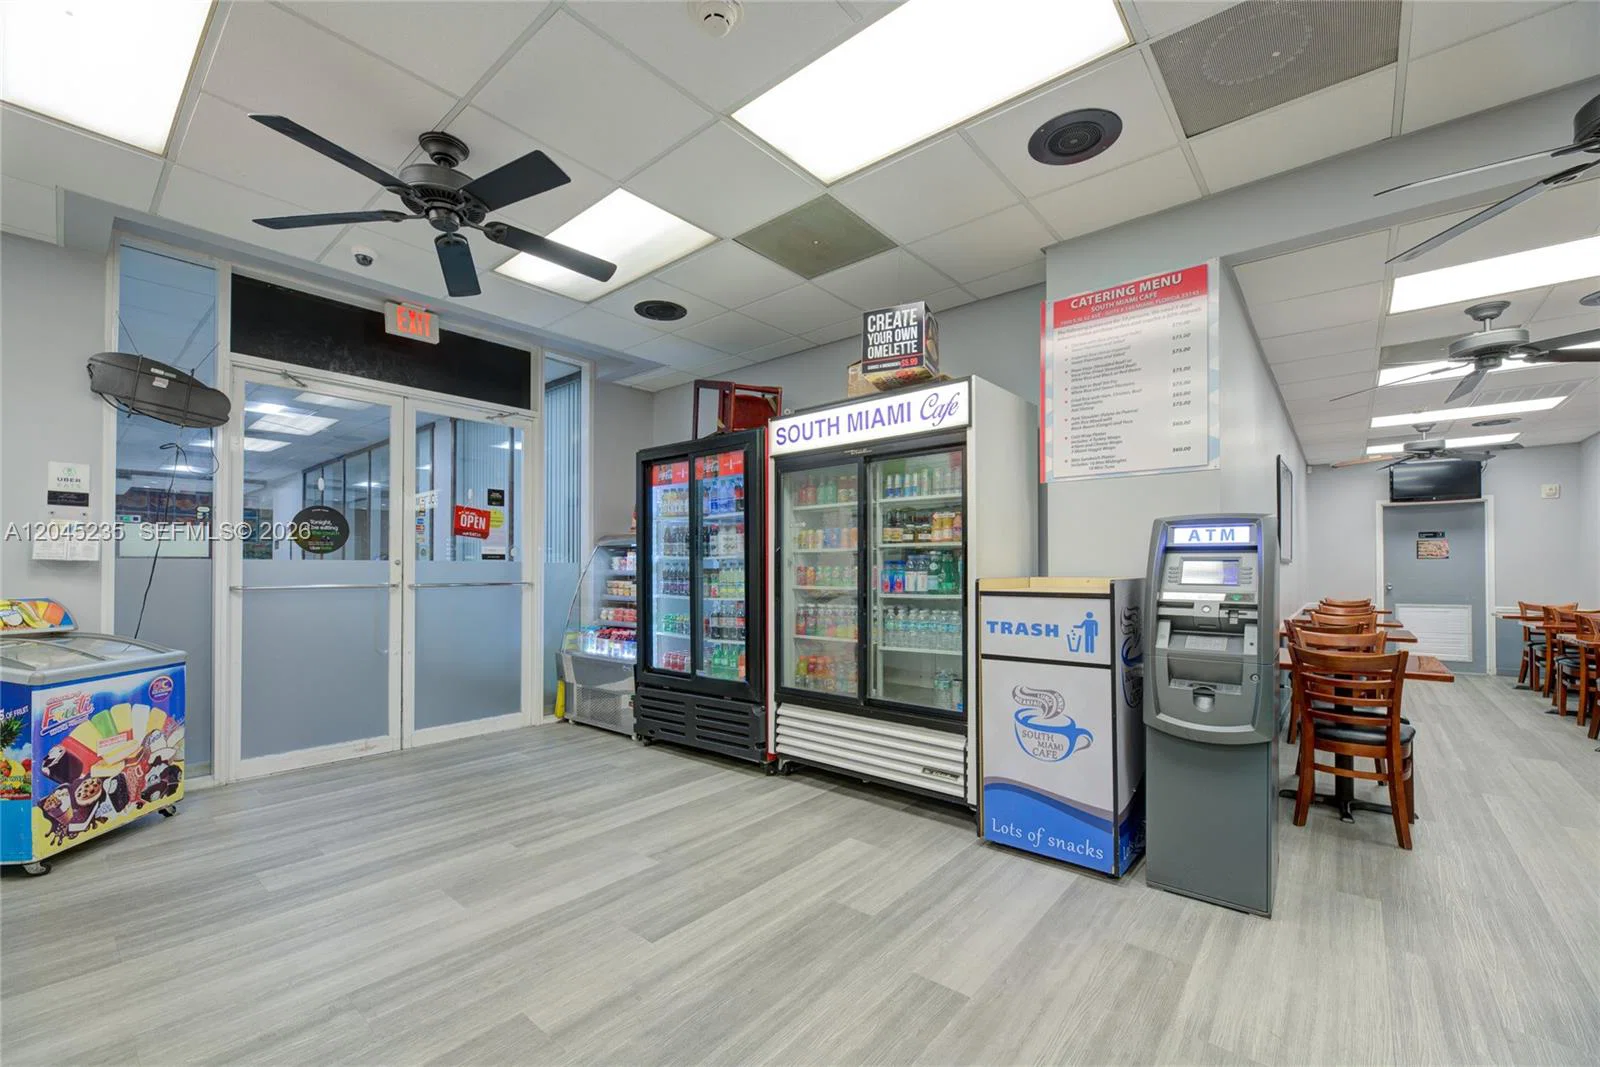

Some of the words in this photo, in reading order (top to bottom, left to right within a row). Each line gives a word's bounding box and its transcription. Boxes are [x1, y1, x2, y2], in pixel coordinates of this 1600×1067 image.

[1070, 284, 1135, 309] CATERING
[1139, 272, 1182, 292] MENU
[1091, 301, 1114, 312] SOUTH
[1115, 295, 1137, 306] MIAMI
[1139, 290, 1157, 300] CAFE
[396, 306, 432, 337] EXIT
[867, 308, 918, 332] CREATE
[867, 330, 893, 346] YOUR
[894, 326, 918, 342] OWN
[867, 340, 918, 359] OMELETTE
[776, 416, 840, 446] SOUTH
[847, 402, 912, 433] MIAMI
[920, 392, 960, 427] Cafe
[460, 514, 486, 530] OPEN
[1188, 528, 1235, 542] ATM
[986, 620, 1059, 638] TRASH
[6, 711, 12, 719] OF
[14, 705, 29, 716] FRUIT
[1022, 729, 1054, 742] SOUTH
[1032, 747, 1058, 760] CAFE
[1038, 740, 1064, 752] MIAMI
[992, 818, 1022, 838] Lots
[1028, 827, 1046, 848] of
[1048, 836, 1104, 860] snacks
